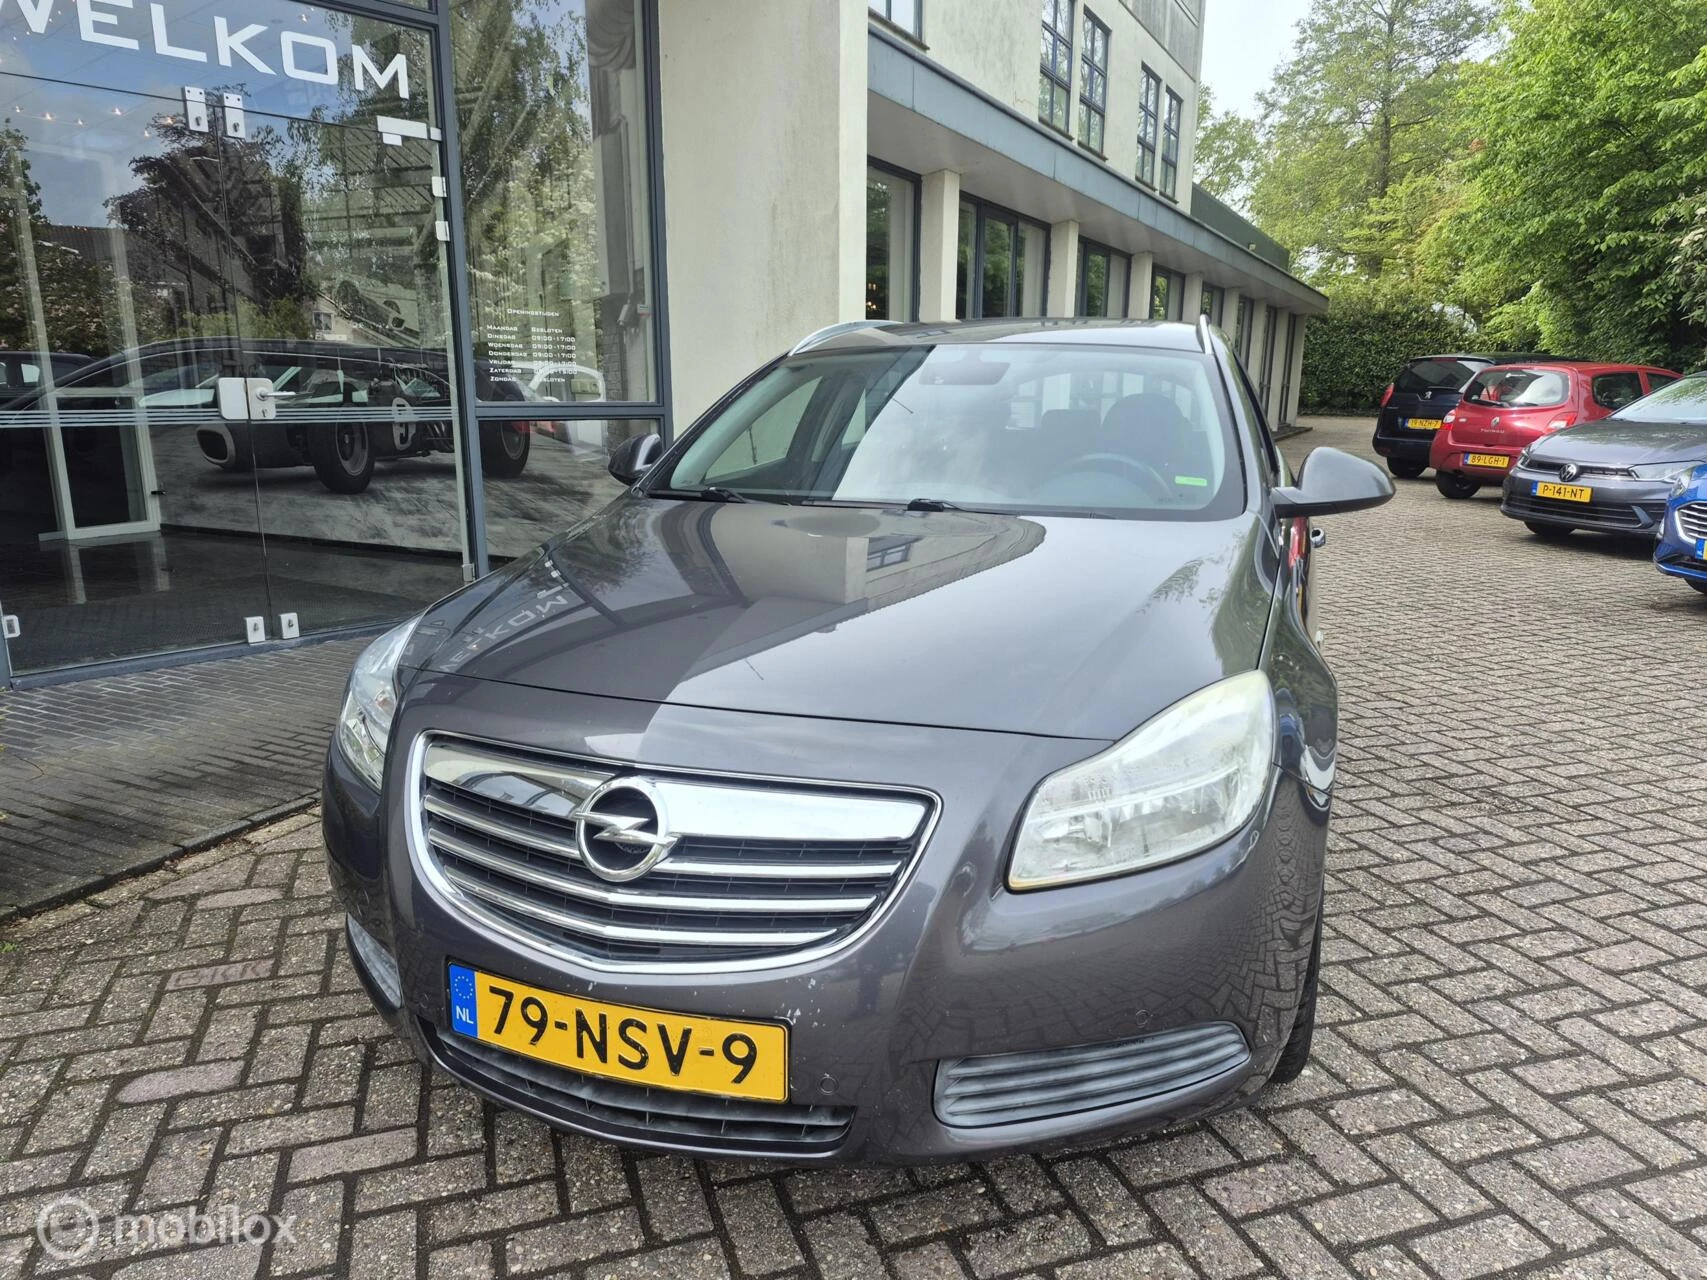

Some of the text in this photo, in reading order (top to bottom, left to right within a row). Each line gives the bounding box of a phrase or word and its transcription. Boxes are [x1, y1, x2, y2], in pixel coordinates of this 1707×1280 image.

[0, 0, 409, 99] ELKOM
[1543, 484, 1585, 499] P-141-NT
[456, 1005, 474, 1025] NL
[488, 985, 758, 1084] 79-NSV-9
